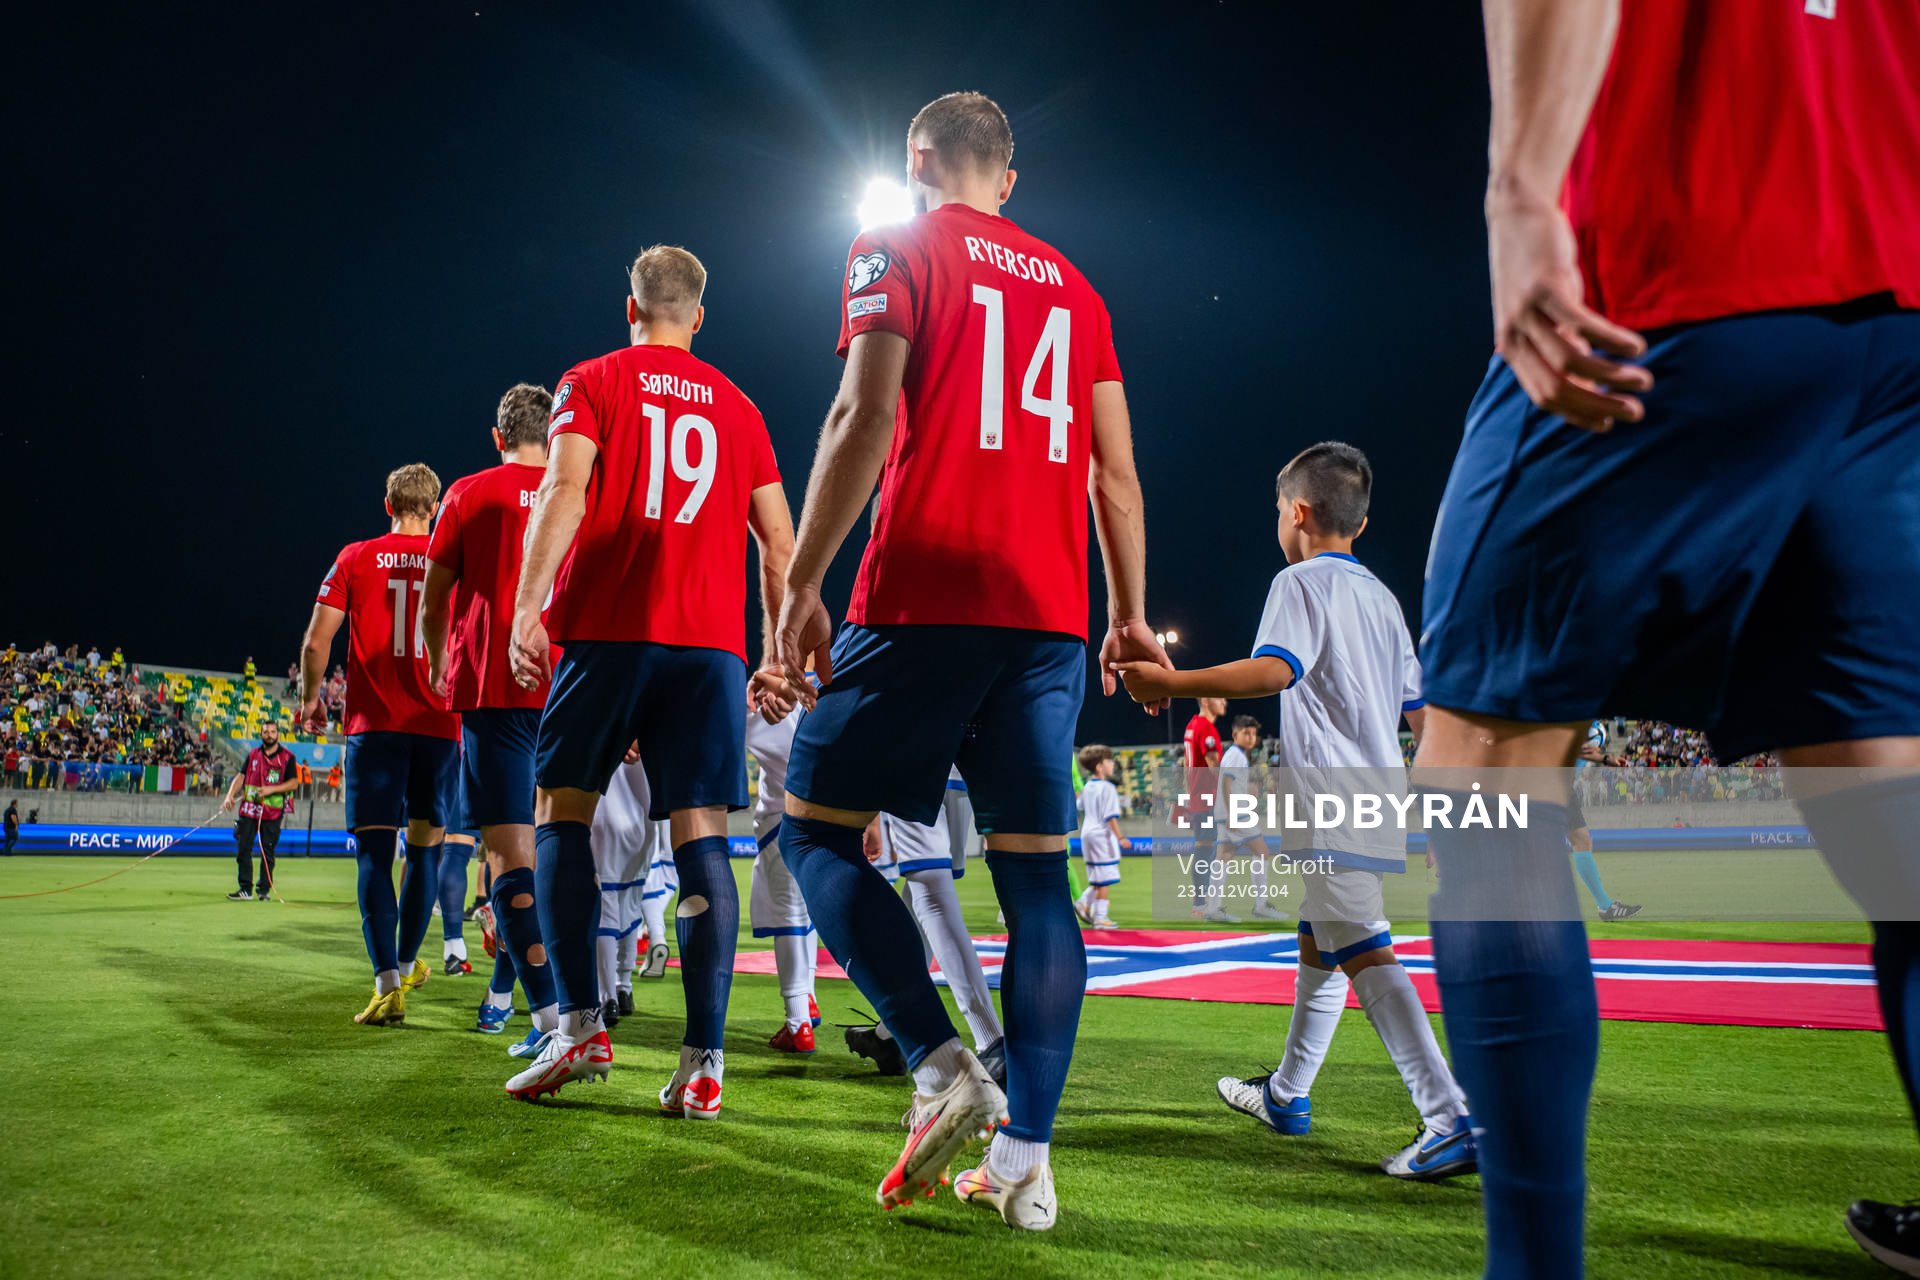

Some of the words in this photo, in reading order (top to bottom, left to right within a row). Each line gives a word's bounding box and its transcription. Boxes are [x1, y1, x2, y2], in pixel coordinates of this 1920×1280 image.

[965, 236, 1063, 287] RYERSON
[639, 372, 713, 405] SØRLOTH
[972, 283, 1073, 464] 14
[642, 402, 718, 524] 19
[376, 552, 427, 569] SOLBAK
[387, 578, 425, 659] 11
[70, 832, 120, 848] PEACE
[1751, 832, 1793, 844] PEACE
